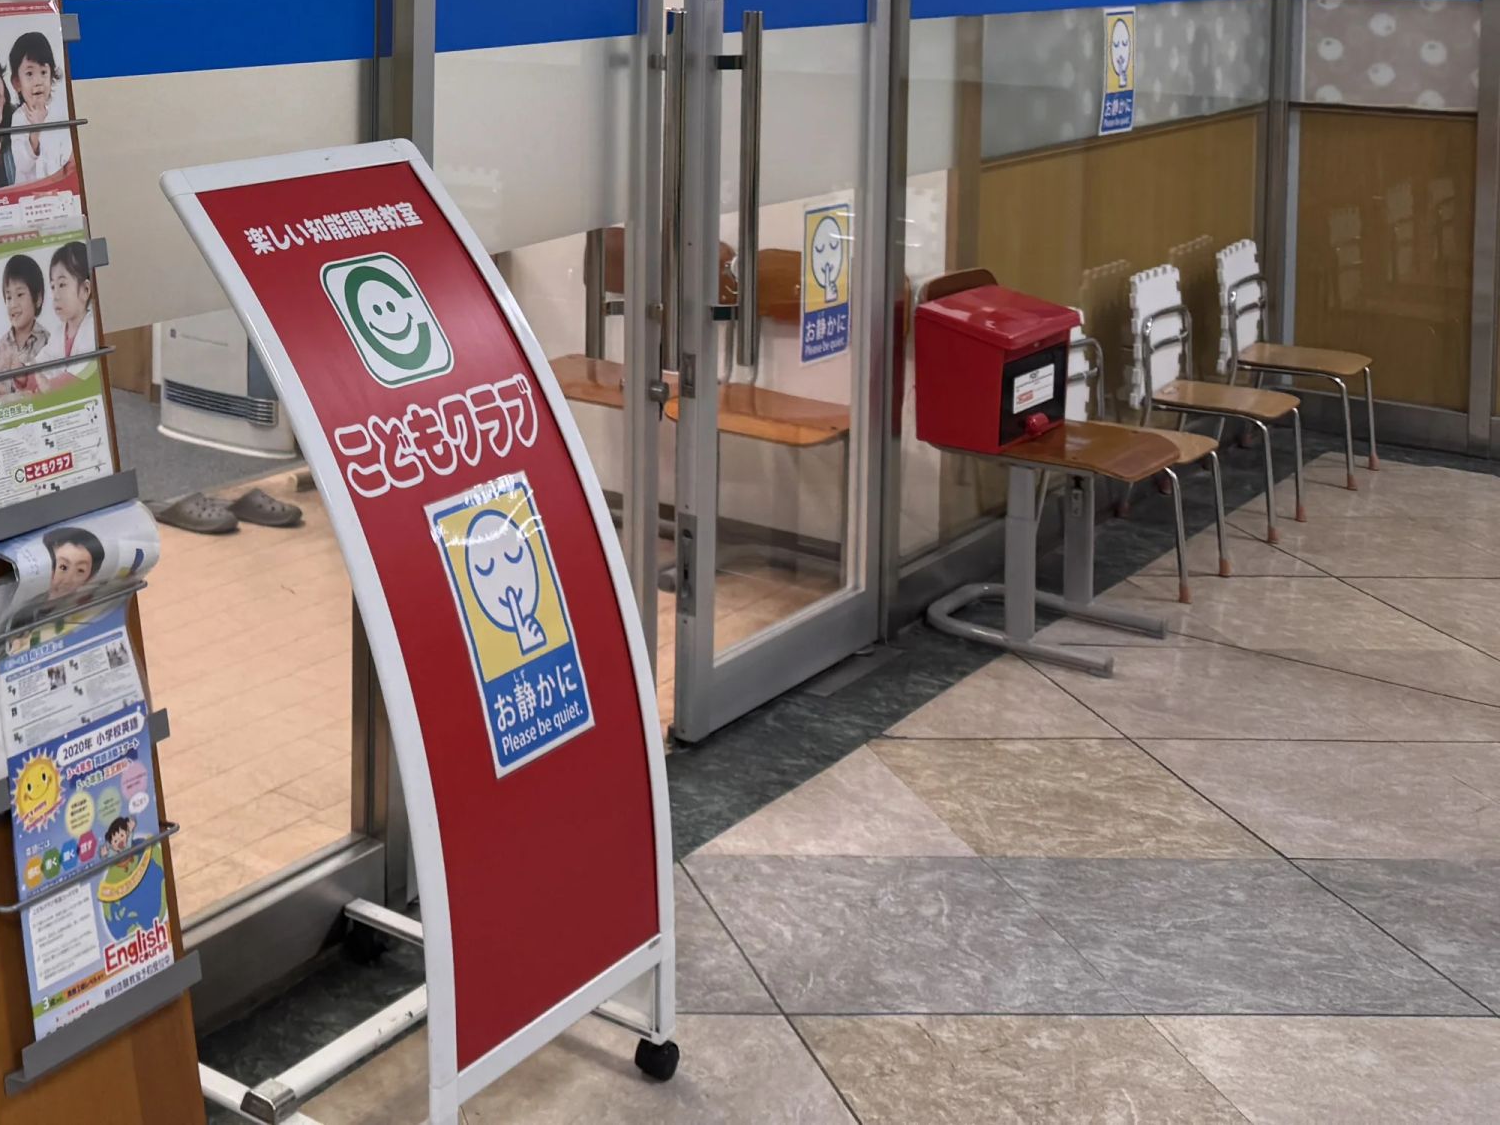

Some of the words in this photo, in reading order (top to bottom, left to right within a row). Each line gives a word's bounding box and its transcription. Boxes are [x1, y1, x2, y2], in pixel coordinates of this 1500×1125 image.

[243, 201, 424, 257] 楽しい知能開発教室
[805, 315, 846, 343] お静かに
[334, 374, 539, 497] こどもクラブ
[494, 663, 578, 732] お静かに
[62, 737, 93, 761] 2020年
[96, 716, 139, 746] 小学校英語
[501, 726, 538, 756] Please
[537, 717, 553, 736] be
[553, 701, 584, 732] quiet.
[104, 919, 167, 973] English
[139, 941, 169, 964] course
